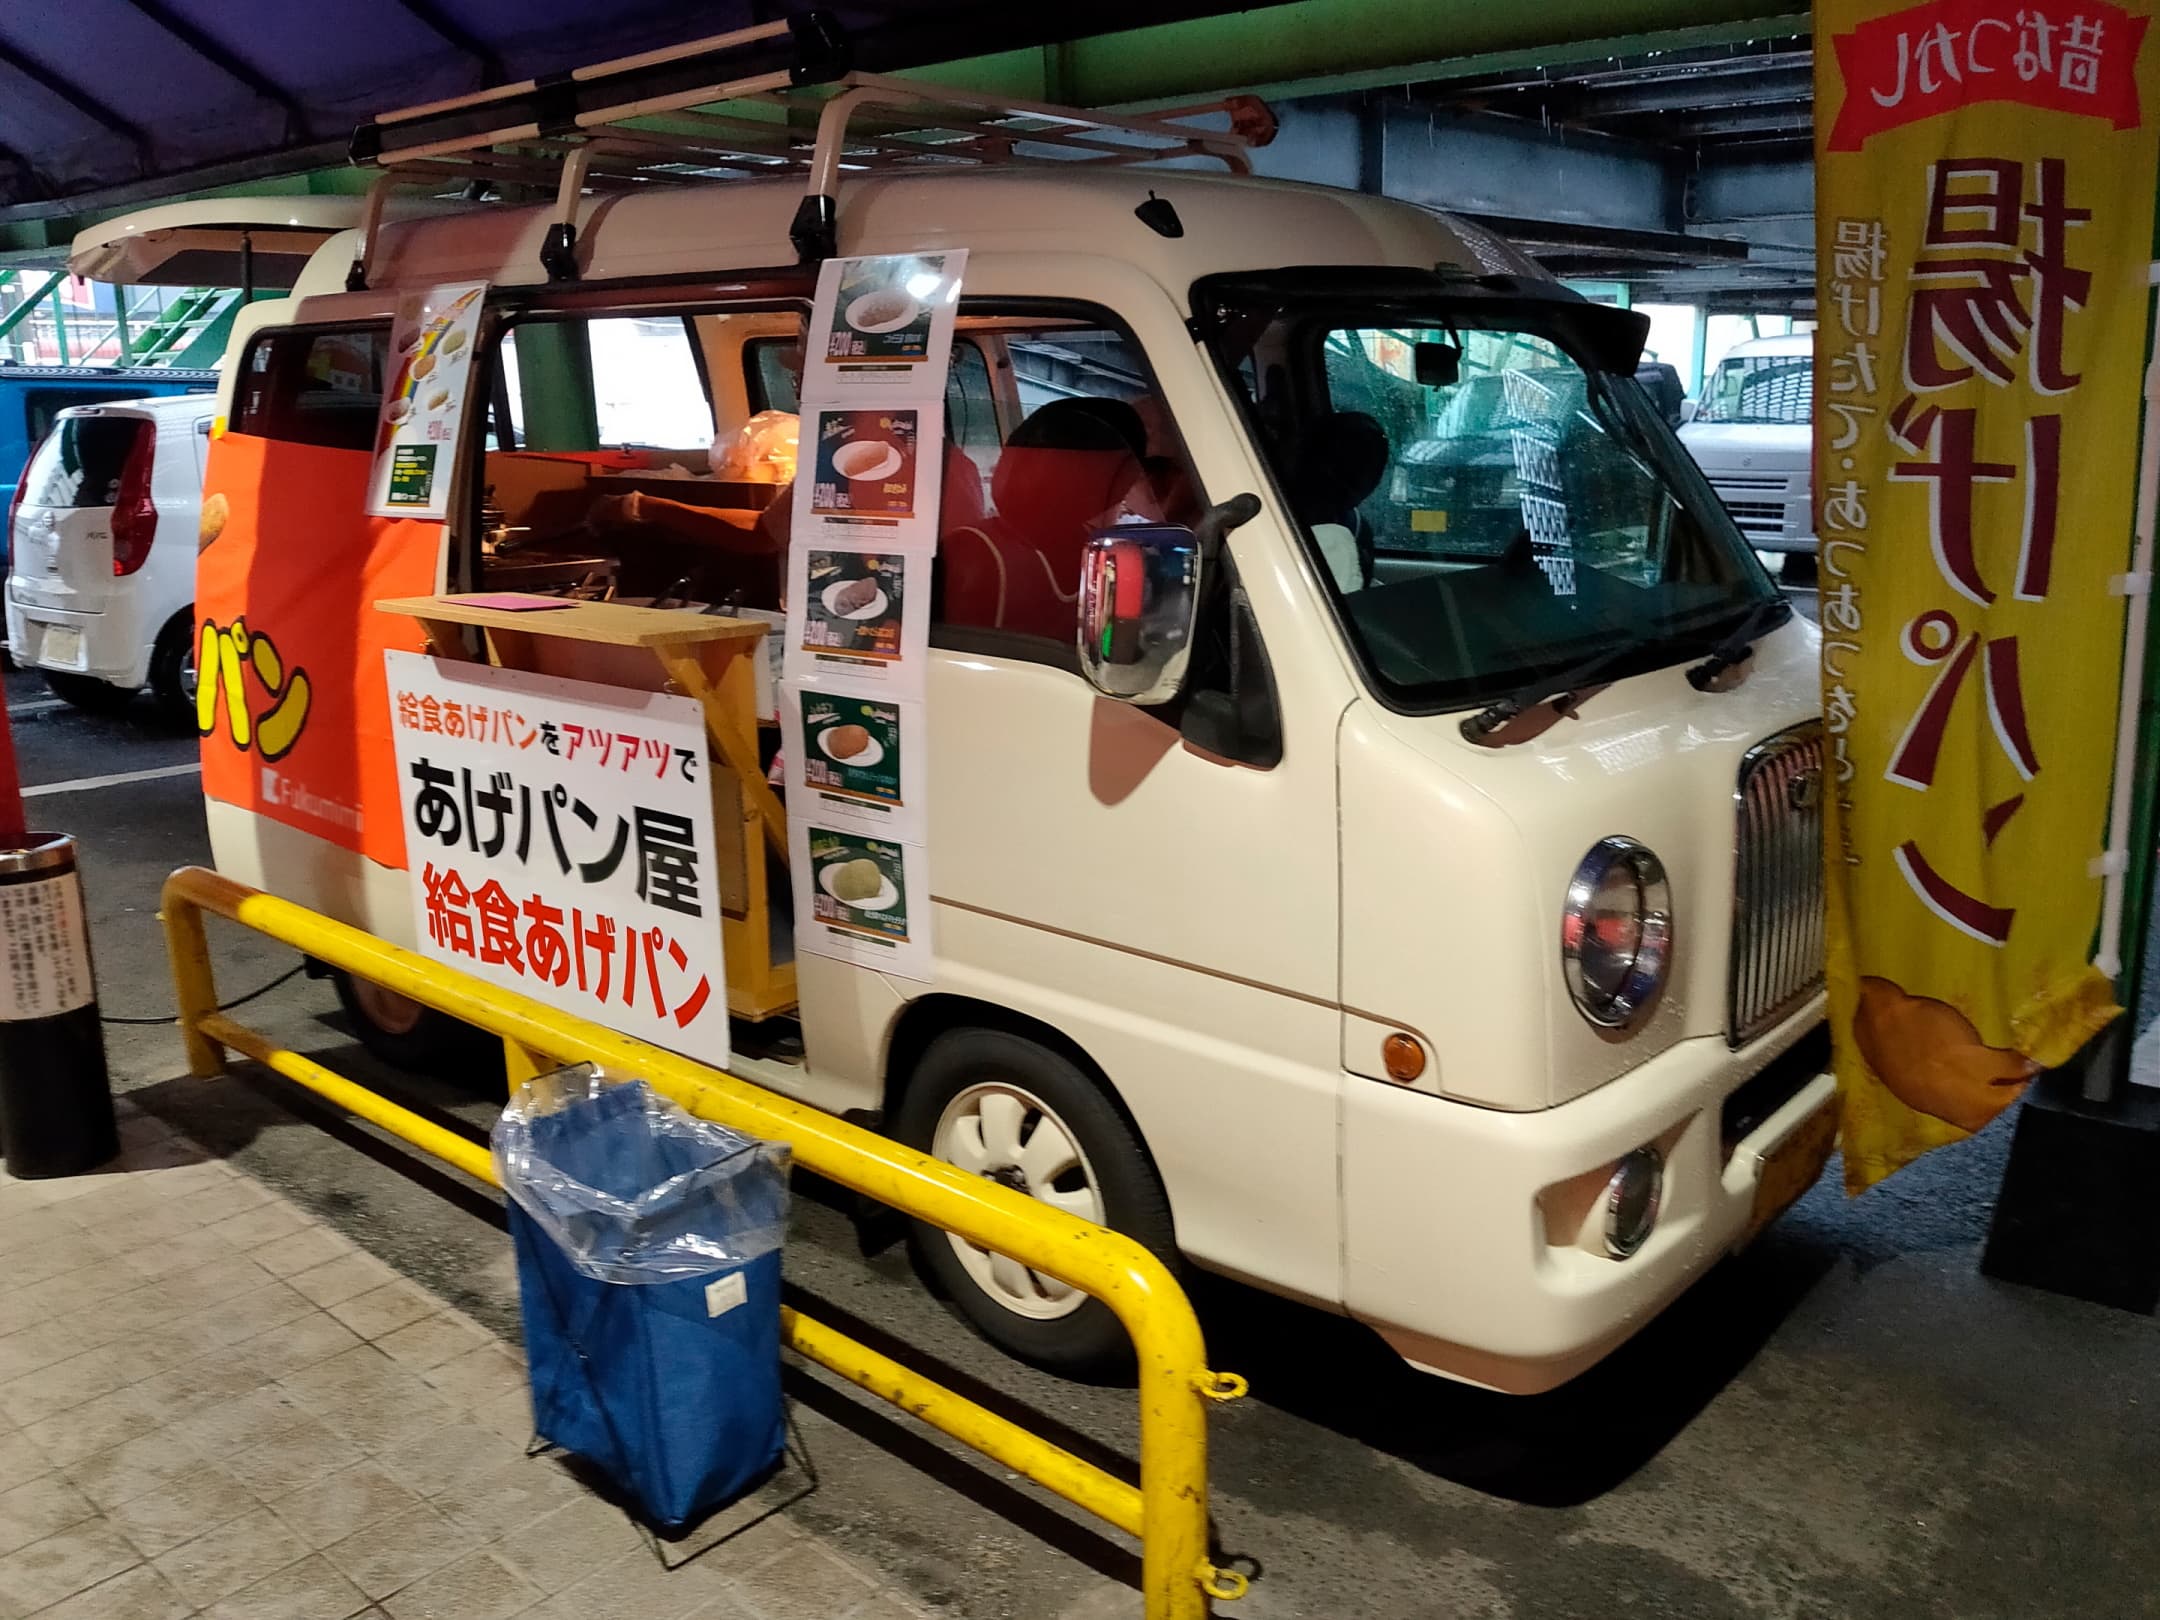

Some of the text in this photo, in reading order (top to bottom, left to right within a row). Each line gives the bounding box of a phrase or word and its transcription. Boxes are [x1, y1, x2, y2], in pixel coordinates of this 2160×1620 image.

[196, 615, 312, 763] パン
[397, 690, 697, 783] 給食あげパンをアツアツで
[409, 756, 703, 918] あげパン屋
[422, 861, 711, 1029] 給食あげパン
